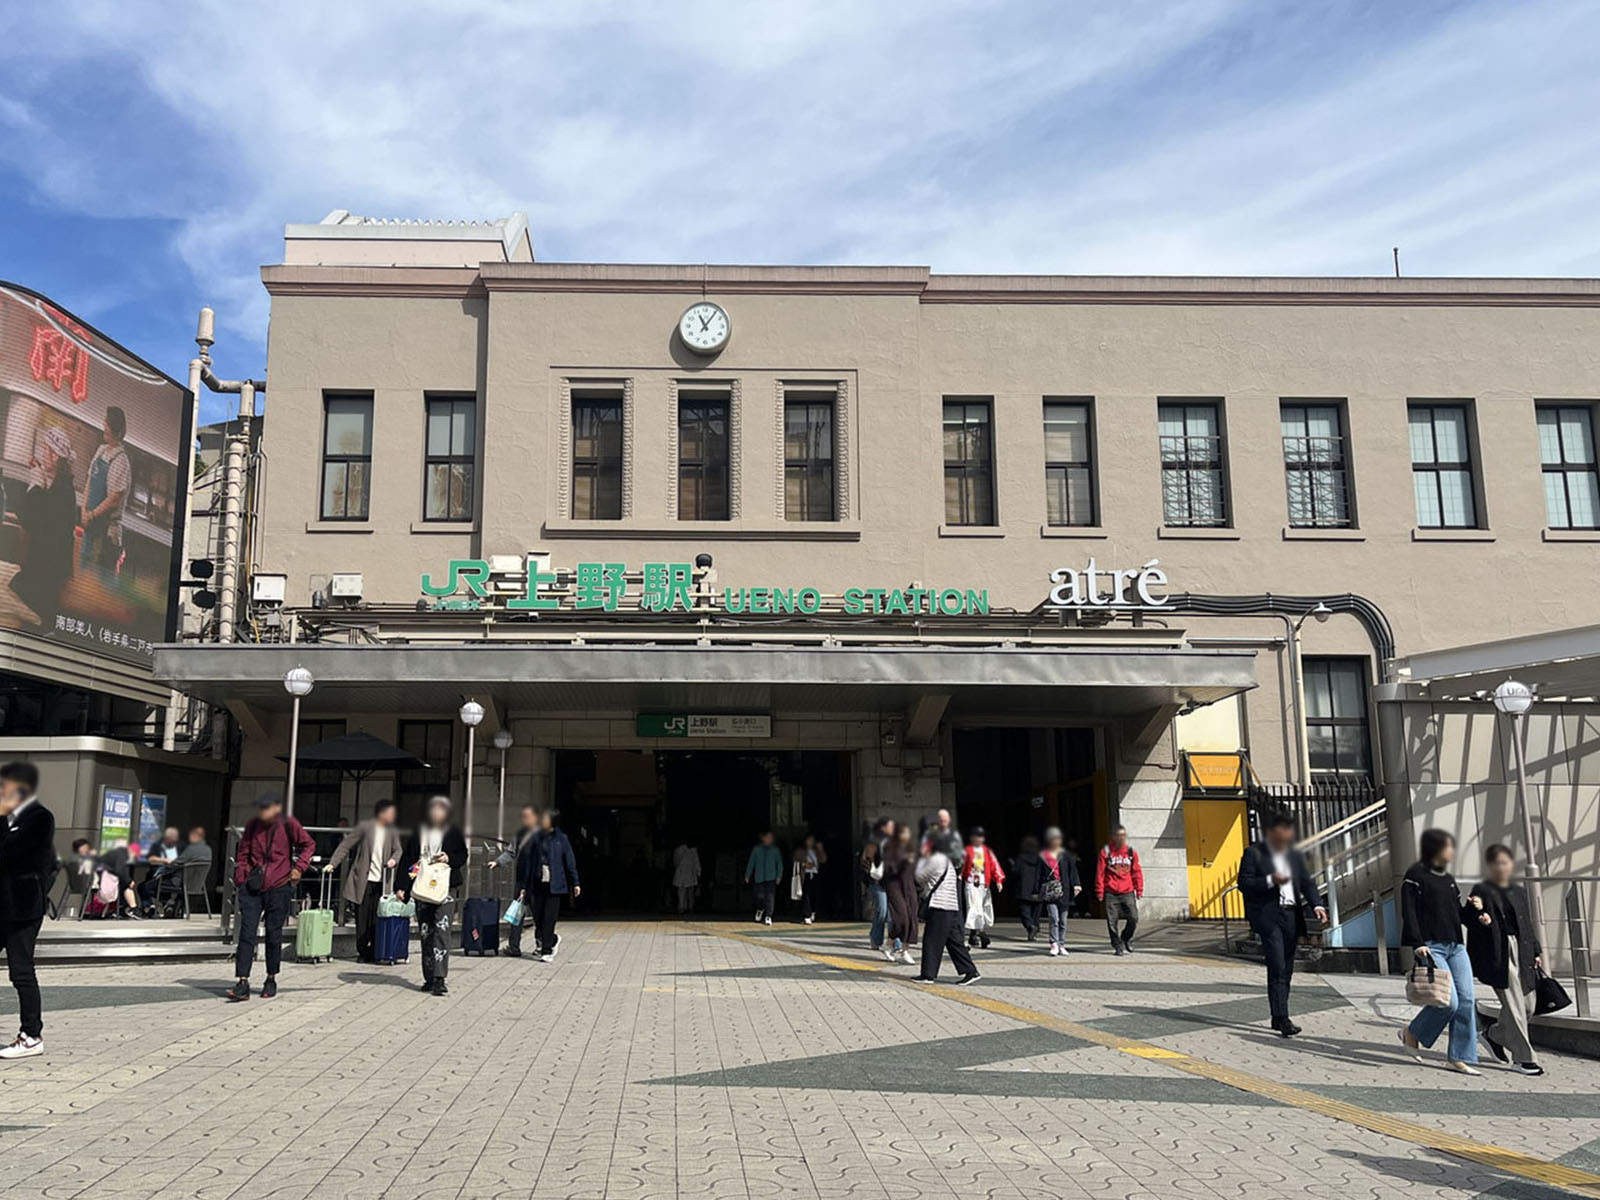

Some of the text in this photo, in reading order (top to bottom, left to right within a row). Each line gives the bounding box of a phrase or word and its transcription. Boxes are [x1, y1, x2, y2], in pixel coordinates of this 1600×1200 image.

[420, 559, 693, 613] JR 上野駅
[1050, 557, 1169, 606] atré
[724, 587, 990, 616] UENO STATION
[663, 717, 686, 730] JR
[690, 717, 718, 728] 上野駅
